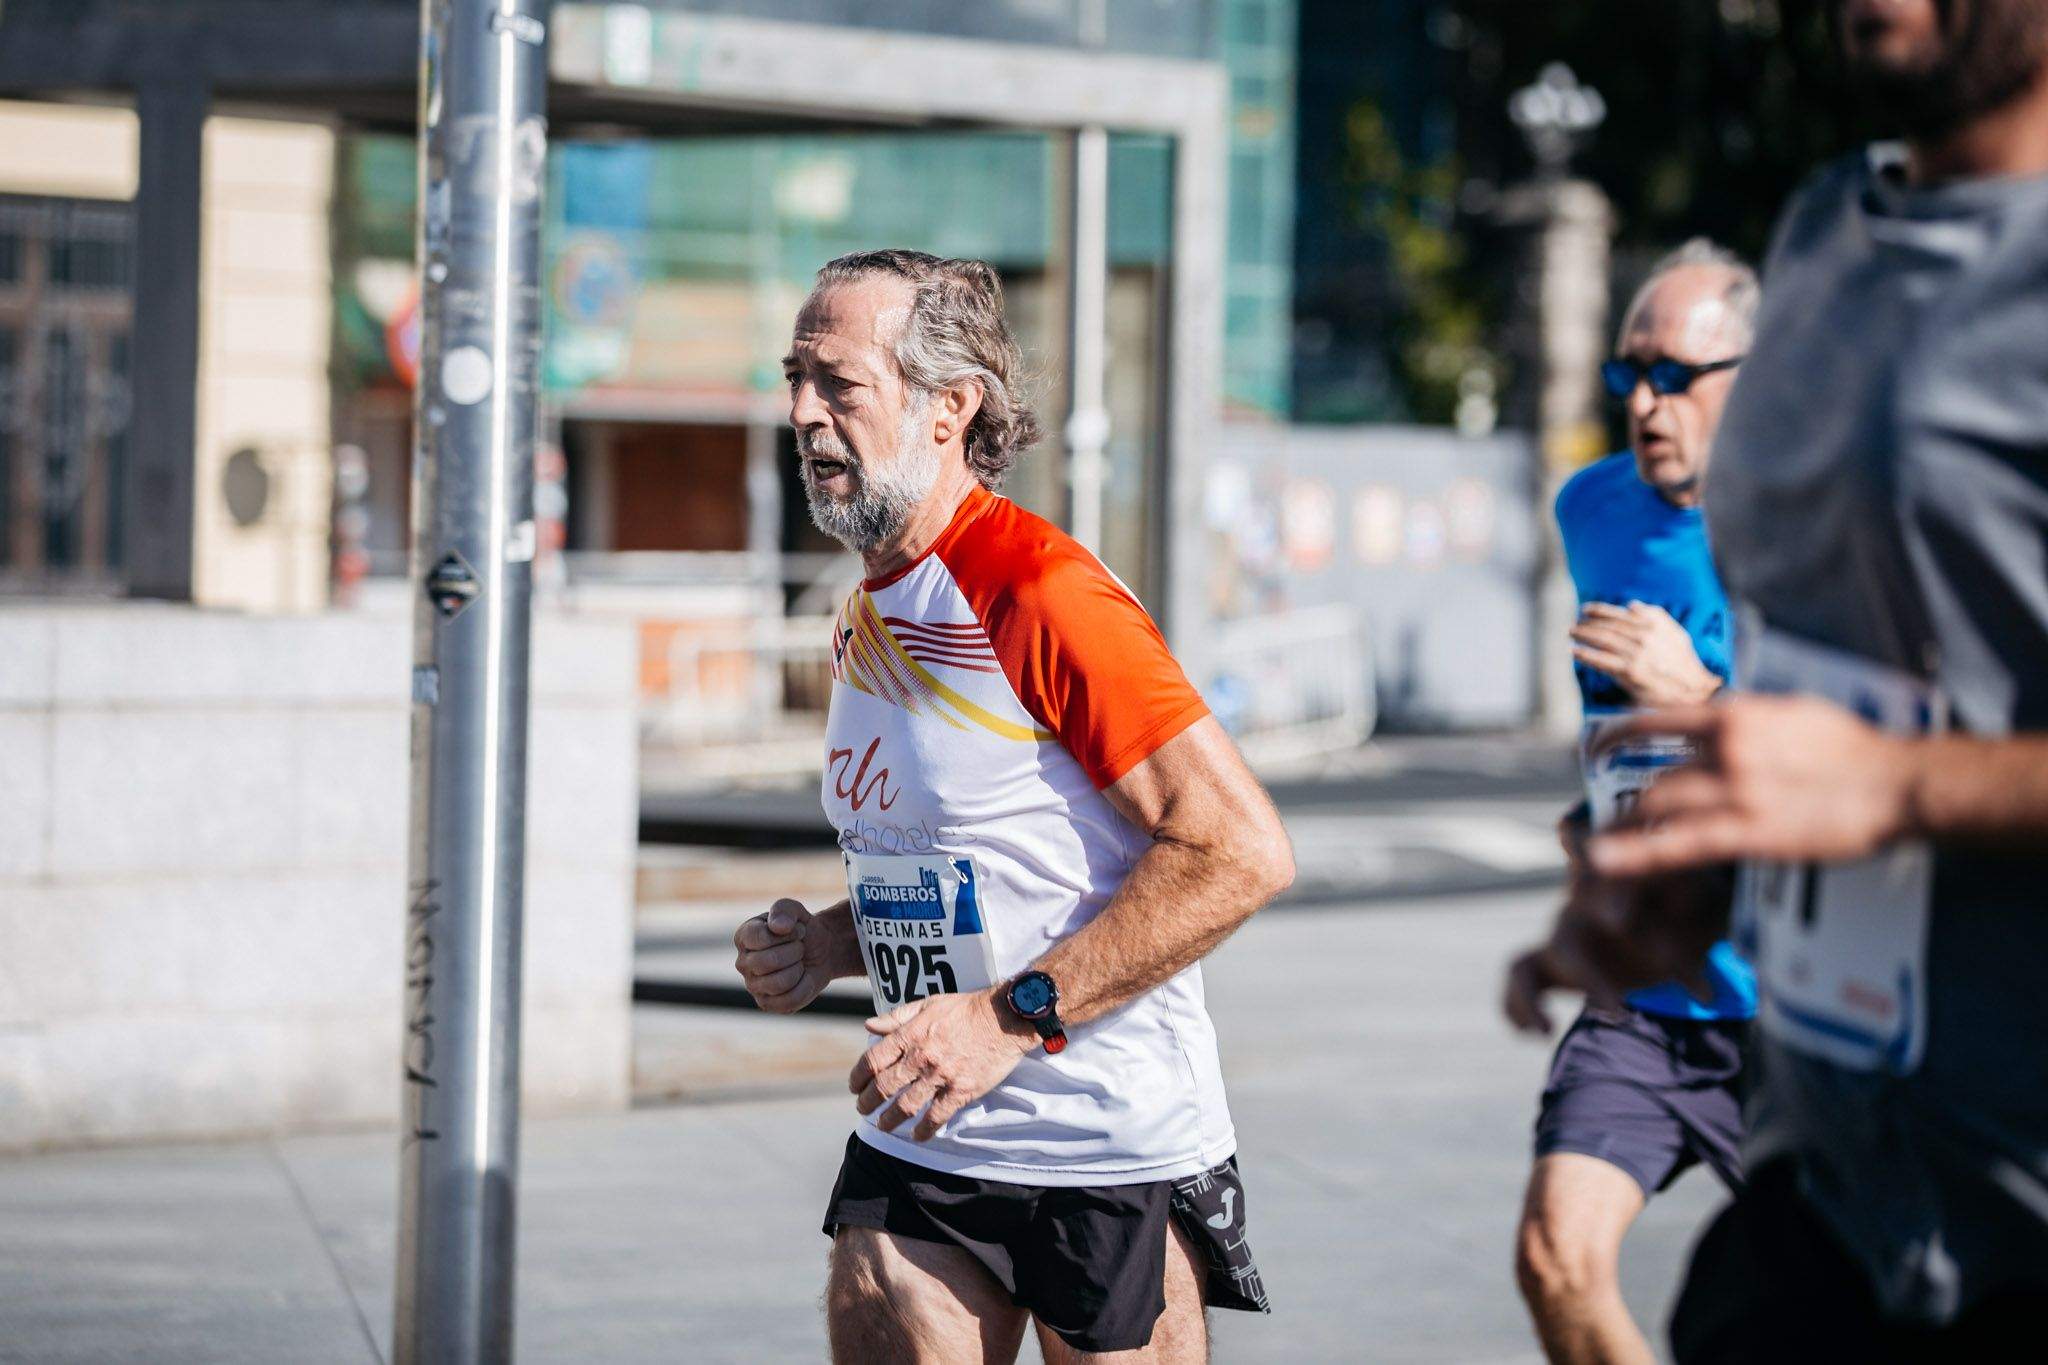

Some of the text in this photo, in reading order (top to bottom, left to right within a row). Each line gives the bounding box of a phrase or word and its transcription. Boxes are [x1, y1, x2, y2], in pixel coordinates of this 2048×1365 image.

[861, 875, 886, 884] CARRERA
[863, 886, 938, 902] BOMBEROS
[865, 919, 944, 938] DECIMAS
[868, 940, 958, 1004] 1925
